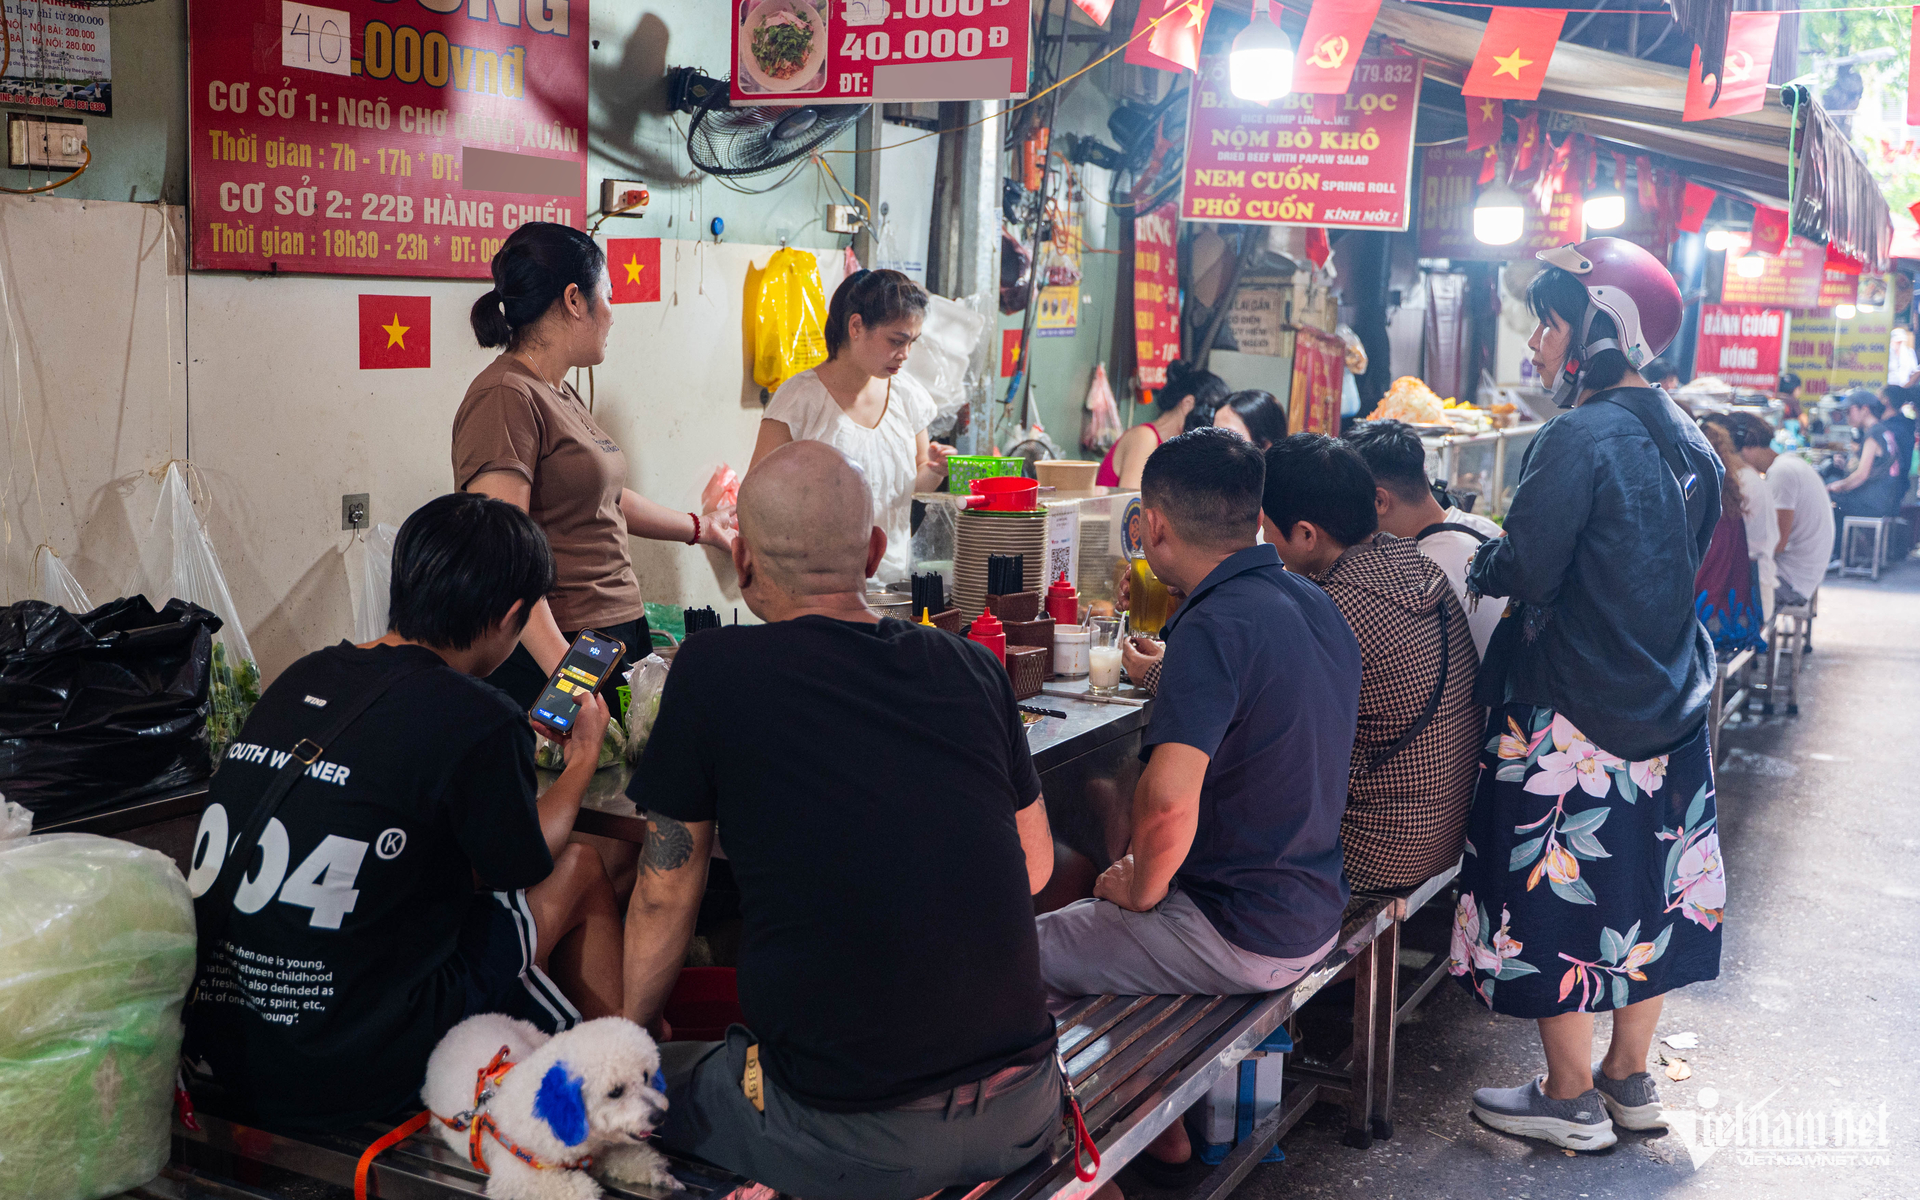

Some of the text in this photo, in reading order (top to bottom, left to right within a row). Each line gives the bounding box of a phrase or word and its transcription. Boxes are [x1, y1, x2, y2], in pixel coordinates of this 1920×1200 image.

[67, 13, 104, 26] 200.000
[65, 27, 95, 40] 200.000
[839, 26, 983, 61] 40.000
[65, 41, 95, 53] 280.000
[839, 72, 868, 93] ĐT:
[1343, 93, 1398, 115] LỌC
[208, 80, 250, 113] CƠ
[258, 77, 297, 119] SỞ
[306, 93, 329, 123] 1:
[338, 96, 391, 130] NGÕ
[400, 105, 448, 143] CHỢ
[522, 120, 579, 153] XUÂN
[1211, 125, 1380, 151] NỘM BÒ KHÔ
[209, 128, 257, 163] Thời
[265, 136, 312, 168] gian
[331, 142, 356, 171] 7h
[377, 148, 411, 177] 17h
[432, 152, 460, 182] ĐT:
[1217, 151, 1369, 166] DRIED BEEF WITH PAPAW SALAD
[1194, 165, 1397, 194] NEM CUỐN SPRING ROLL
[219, 181, 265, 213] CƠ
[274, 175, 318, 217] SỞ
[325, 190, 351, 219] 2:
[361, 192, 414, 223] 22B
[424, 193, 494, 228] HÀNG
[1191, 192, 1242, 217] PHỞ
[1245, 194, 1315, 220] CUỐN
[1323, 207, 1362, 222] KÍNH
[210, 220, 254, 254] Thời
[262, 226, 304, 258] gian
[323, 229, 379, 259] 18h30
[396, 232, 428, 261] 23h
[451, 235, 476, 263] ĐT:
[1703, 308, 1780, 337] BÁNH CUỐN
[1719, 343, 1759, 370] NÓNG
[304, 695, 327, 708] WIND
[256, 952, 274, 965] one
[276, 956, 285, 966] is
[287, 959, 326, 971] young,
[276, 970, 333, 982] childhood
[248, 980, 268, 991] also
[270, 983, 319, 996] definded
[321, 987, 334, 996] as
[215, 992, 227, 1001] of
[228, 995, 245, 1006] one
[270, 997, 300, 1010] spirit,
